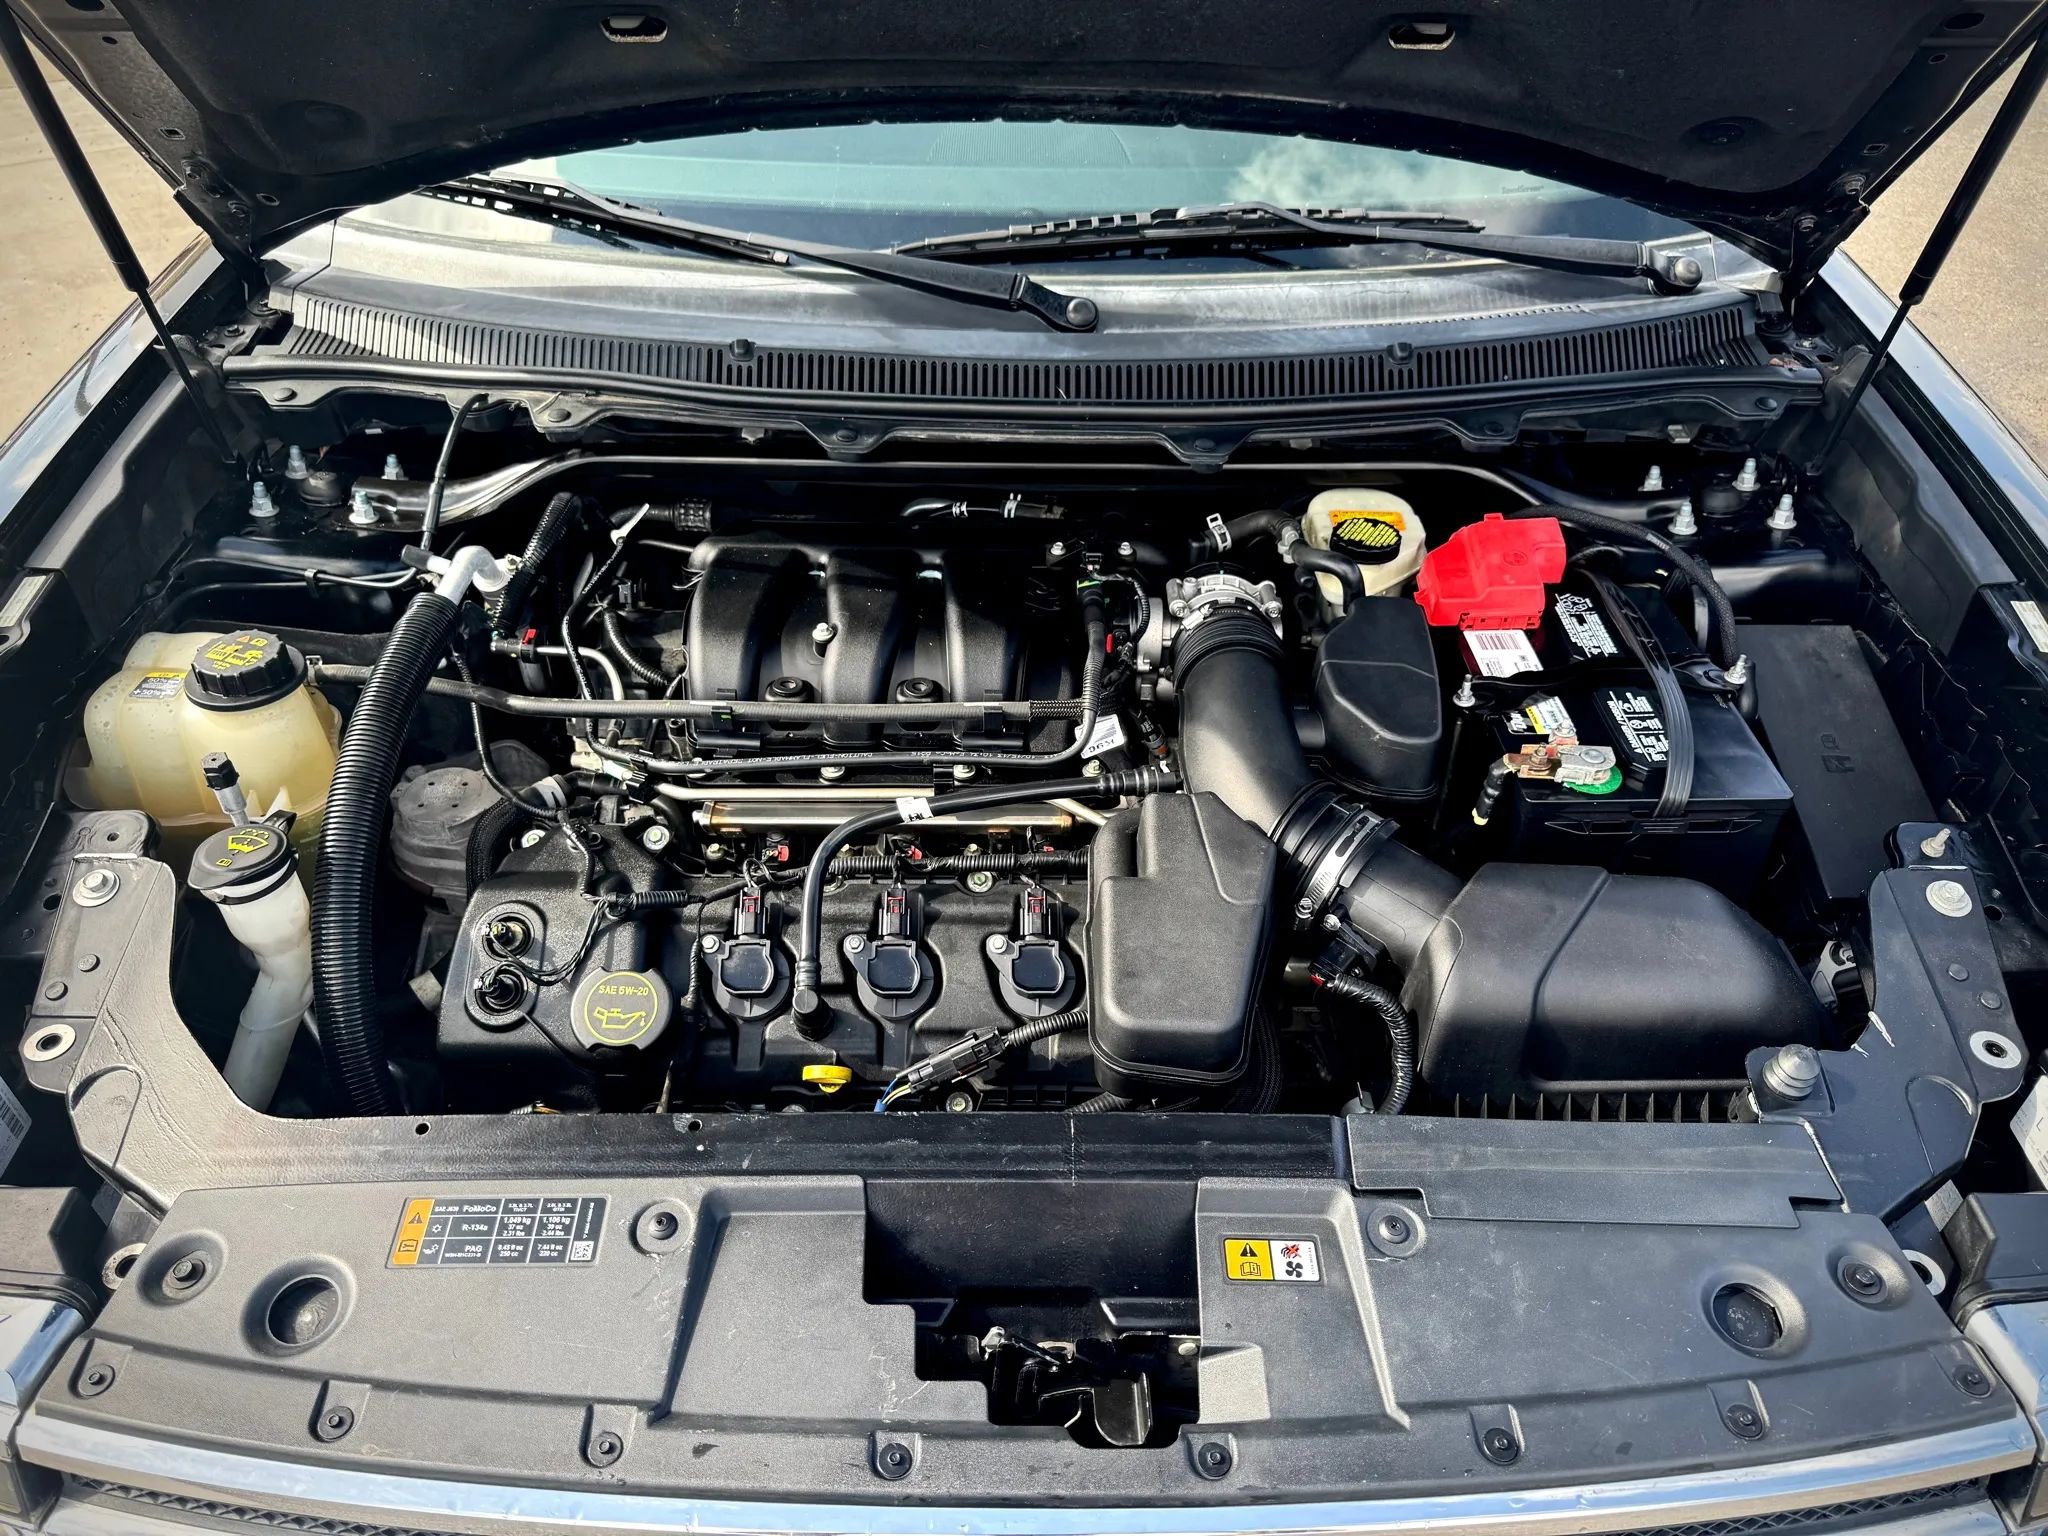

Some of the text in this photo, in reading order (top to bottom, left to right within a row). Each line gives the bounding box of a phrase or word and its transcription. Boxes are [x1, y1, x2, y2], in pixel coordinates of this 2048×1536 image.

[598, 985, 649, 996] SAE 5W-20
[463, 1204, 497, 1212] FoMoCo
[522, 1216, 531, 1225] kg
[542, 1216, 571, 1225] 1.106 kg
[462, 1223, 488, 1231] R-134a
